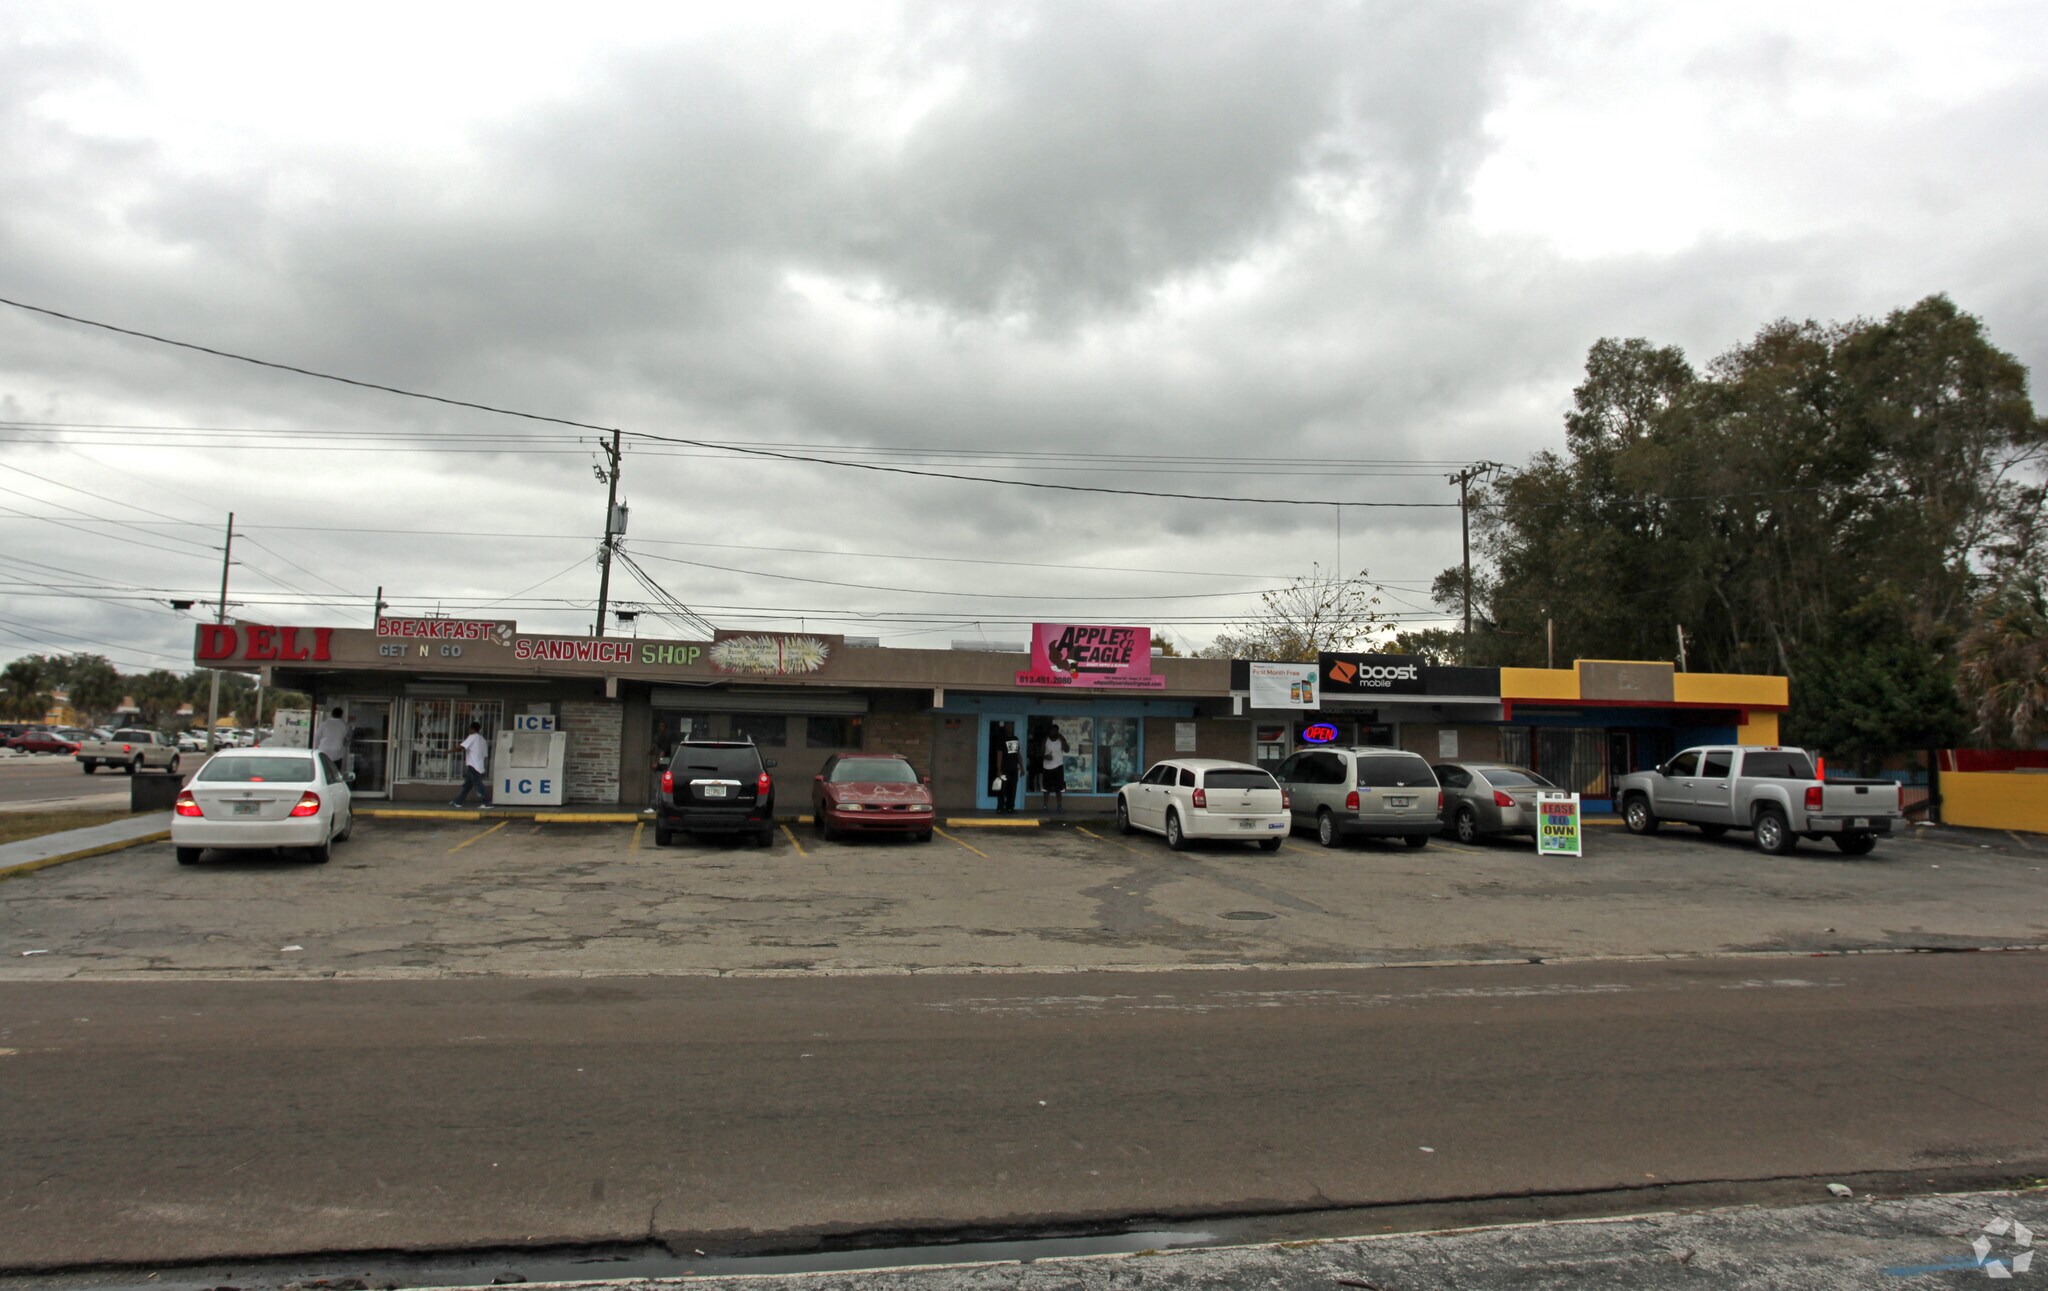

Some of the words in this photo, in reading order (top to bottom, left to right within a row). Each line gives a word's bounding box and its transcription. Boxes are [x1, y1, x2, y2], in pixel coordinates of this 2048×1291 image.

[376, 618, 495, 640] BREAKFAST
[197, 624, 333, 660] DELI
[1056, 626, 1121, 649] APPLE
[380, 644, 408, 656] GET
[419, 644, 429, 657] N
[440, 645, 462, 657] GO
[514, 639, 633, 663] SANDWICH
[641, 644, 701, 666] SHOP
[1074, 646, 1132, 664] EAGLE
[1359, 662, 1418, 680] boost
[1019, 675, 1072, 685] 813.451.2080
[1359, 680, 1391, 688] mobile
[517, 716, 553, 730] ICE
[1305, 726, 1334, 741] OPEN
[505, 779, 551, 794] ICE
[1543, 803, 1574, 814] LEASE
[1551, 815, 1567, 825] TO
[1544, 825, 1574, 836] OWN
